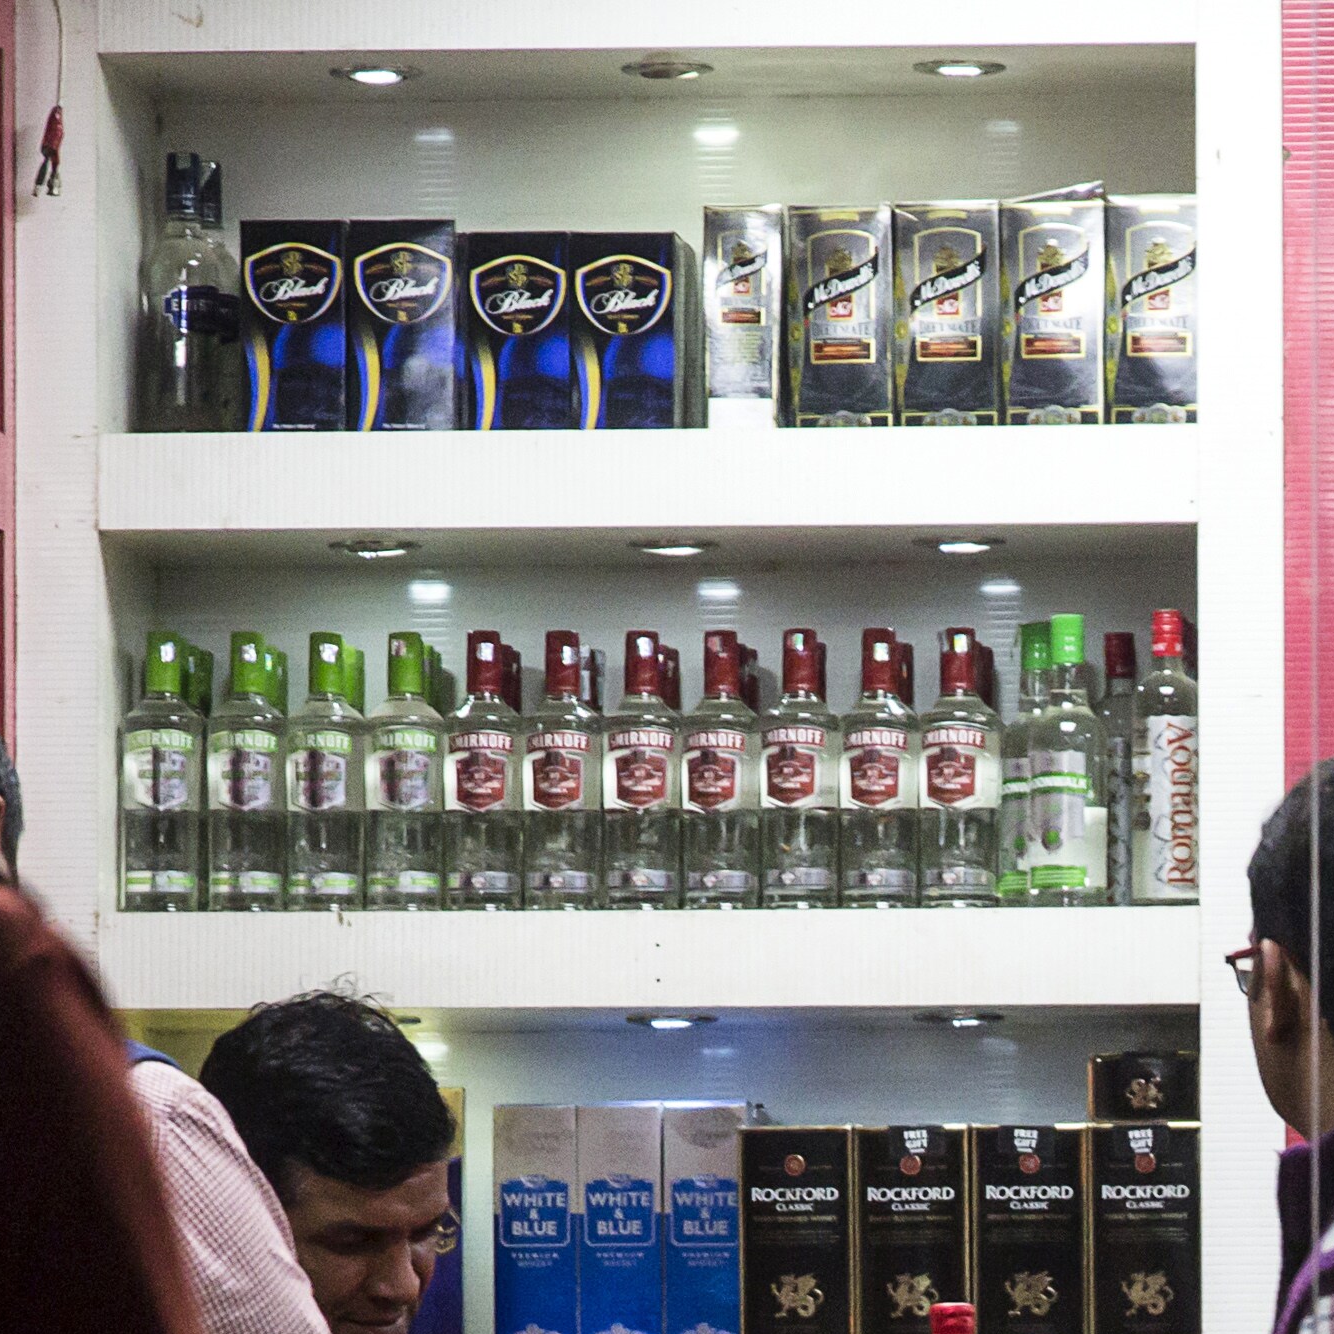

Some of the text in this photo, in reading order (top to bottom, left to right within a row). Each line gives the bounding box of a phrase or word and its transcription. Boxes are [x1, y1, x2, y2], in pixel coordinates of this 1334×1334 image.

[259, 276, 329, 302] Black
[369, 276, 439, 302] Black
[486, 288, 554, 314] Black
[591, 288, 659, 314] Black
[611, 732, 672, 748] SMIRNOFF
[503, 1192, 567, 1208] WHITE
[588, 1192, 651, 1207] WHITE
[674, 1191, 739, 1207] WHITE
[751, 1187, 839, 1203] ROCKFORD
[866, 1186, 955, 1202] ROCKFORD
[985, 1185, 1074, 1200] ROCKFORD
[1101, 1184, 1190, 1200] ROCKFORD
[700, 1207, 710, 1219] &
[775, 1203, 814, 1212] CLASSIC
[891, 1203, 931, 1212] CLASSIC
[1010, 1201, 1049, 1210] CLASSIC
[1125, 1200, 1165, 1210] CLASSIC
[529, 1208, 539, 1220] &
[614, 1208, 624, 1219] &
[511, 1220, 558, 1236] BLUE
[597, 1220, 643, 1236] BLUE
[683, 1219, 730, 1236] BLUE
